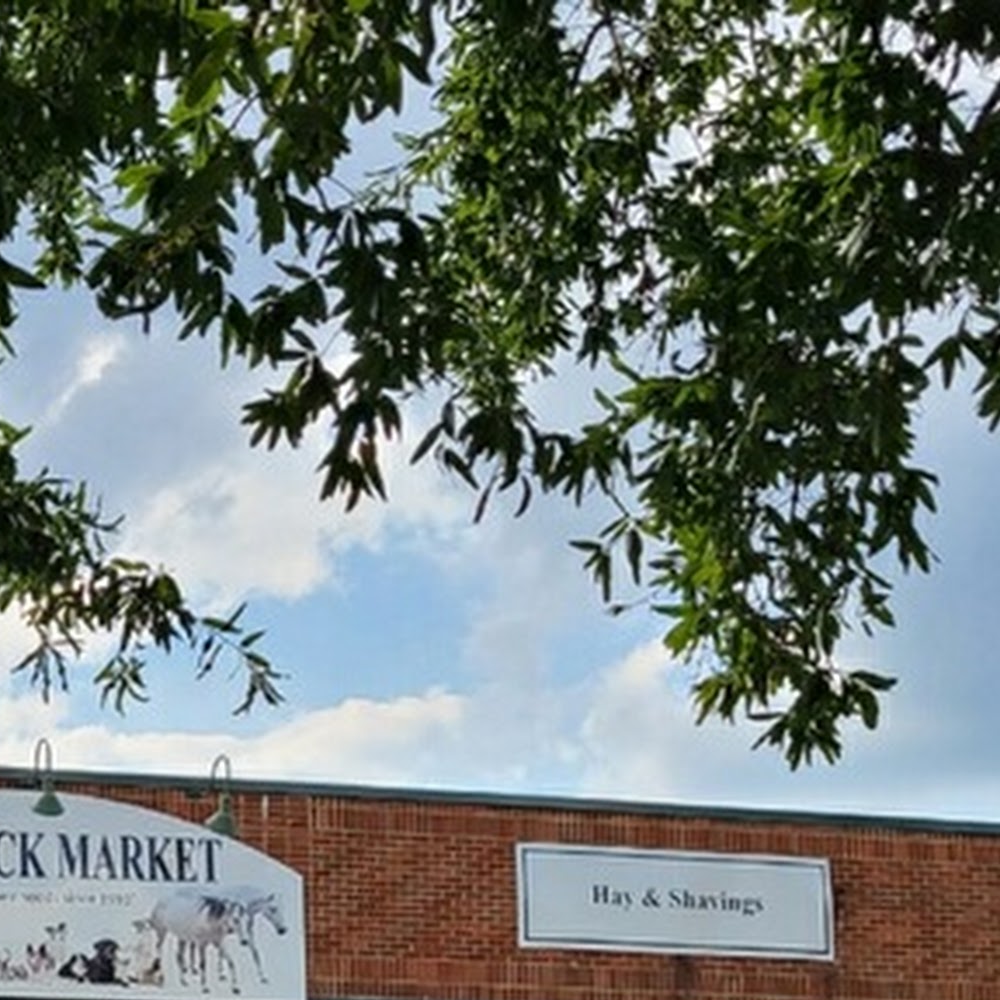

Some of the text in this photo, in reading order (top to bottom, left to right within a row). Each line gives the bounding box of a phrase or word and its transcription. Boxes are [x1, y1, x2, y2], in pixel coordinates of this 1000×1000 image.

[57, 832, 222, 884] MARKET
[592, 885, 765, 916] Hay & Shavings
